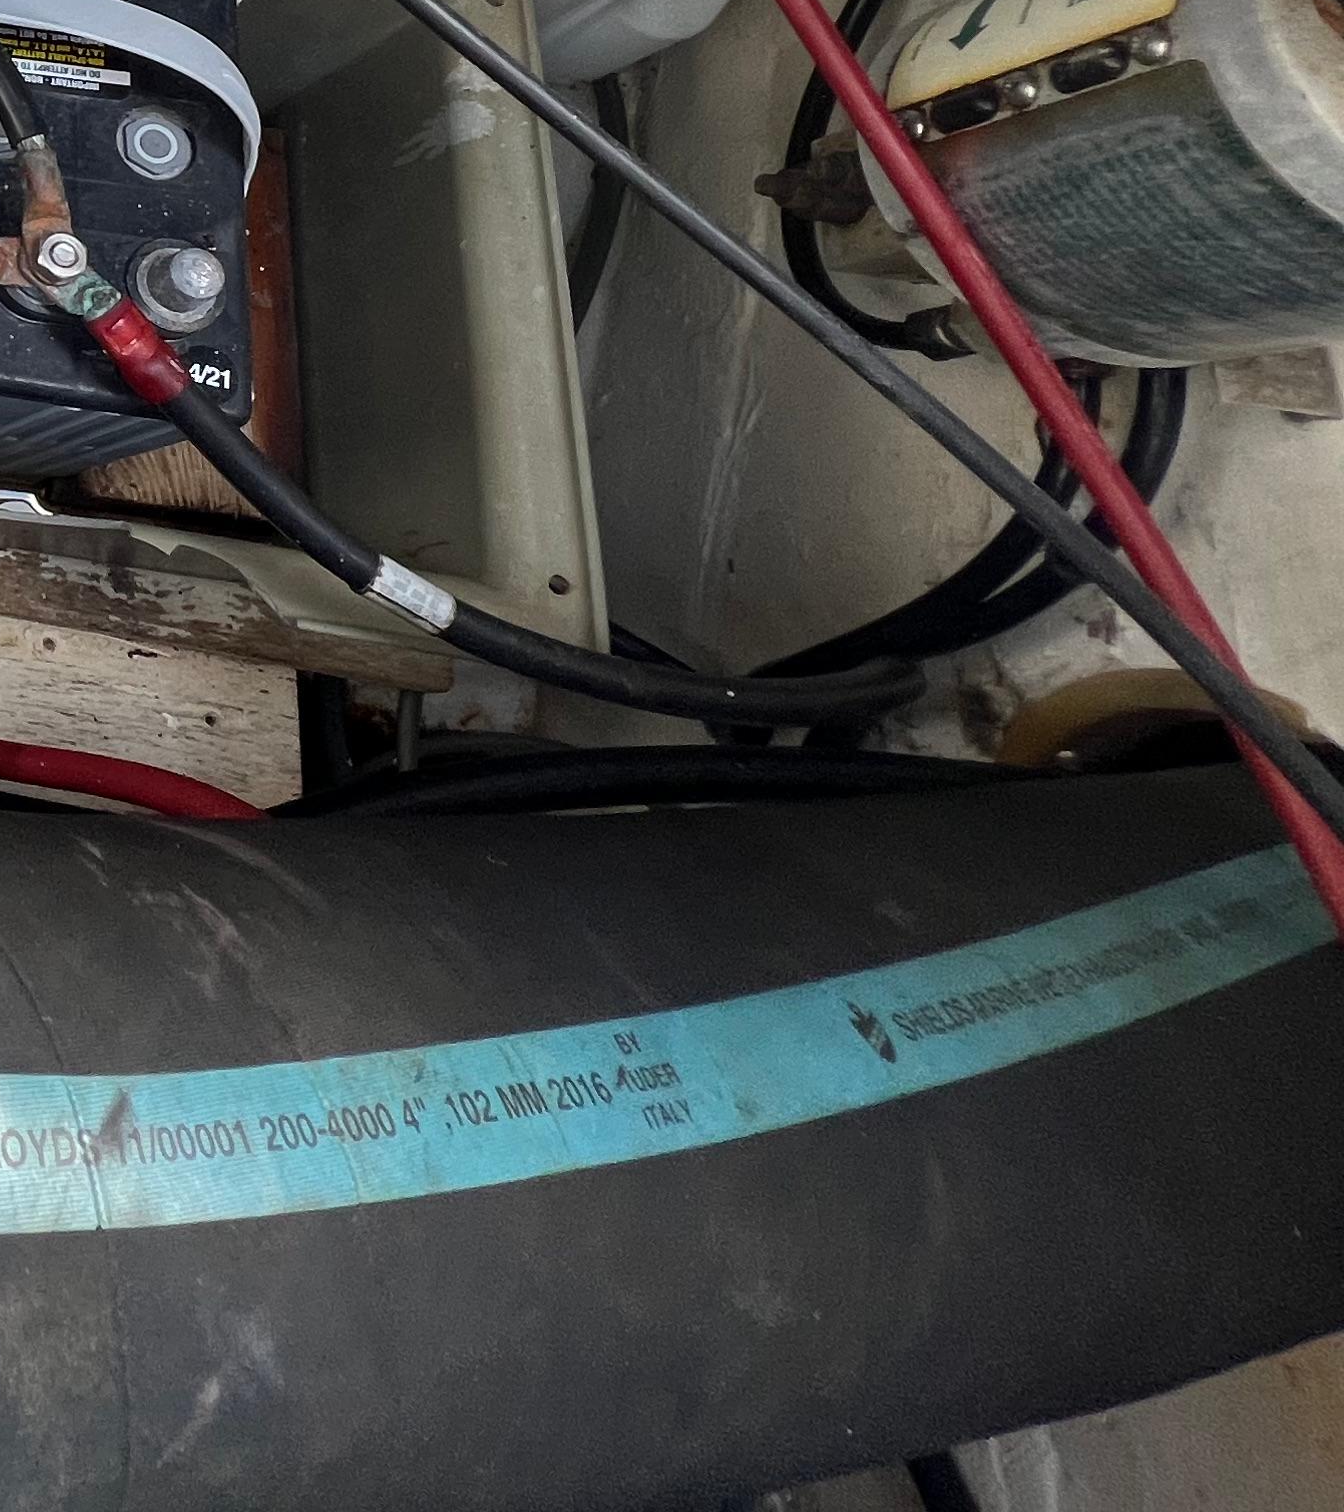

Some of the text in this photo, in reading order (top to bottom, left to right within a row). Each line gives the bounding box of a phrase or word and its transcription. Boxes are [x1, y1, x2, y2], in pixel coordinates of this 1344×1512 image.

[34, 63, 68, 74] ATTEMPT
[189, 363, 230, 389] 4/21
[614, 1032, 642, 1056] BY
[259, 1103, 396, 1152] 200-4000
[402, 1096, 426, 1133] 4"
[494, 1080, 548, 1120] MM
[546, 1072, 612, 1110] 2016
[642, 1099, 694, 1130] ITALY
